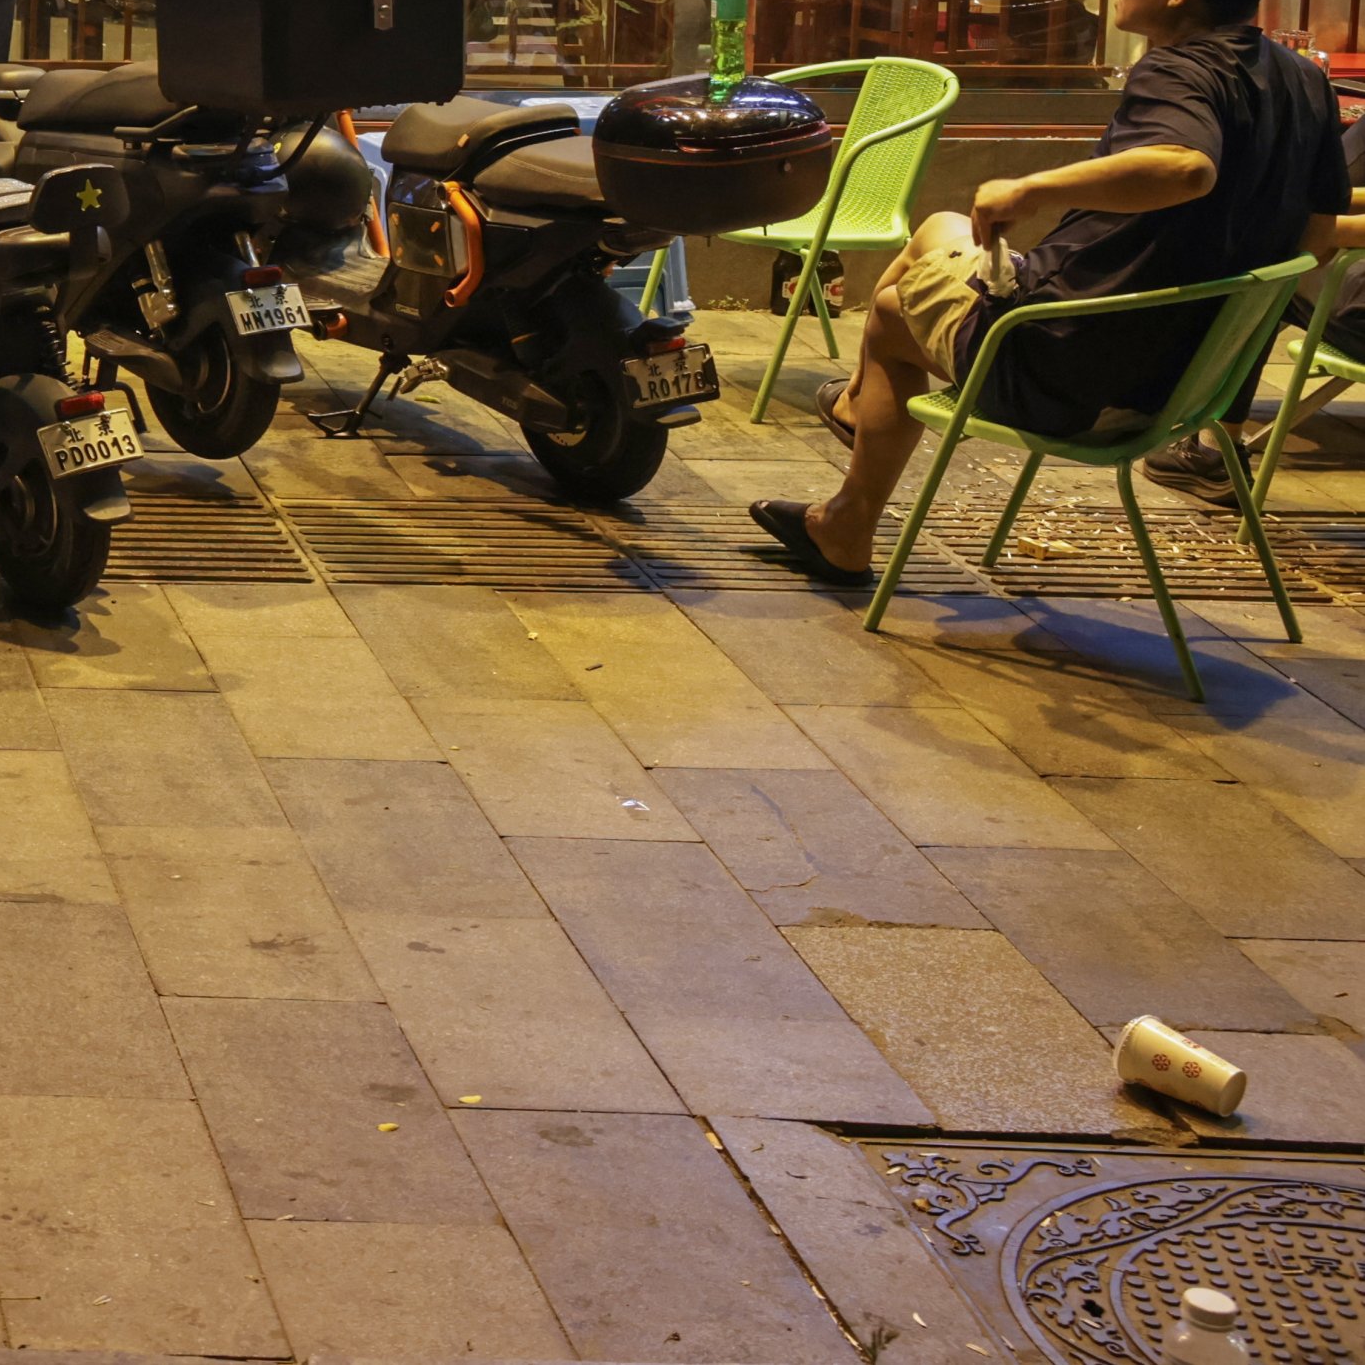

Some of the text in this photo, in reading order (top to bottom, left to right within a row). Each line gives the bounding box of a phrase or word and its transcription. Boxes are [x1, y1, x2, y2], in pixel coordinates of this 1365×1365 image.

[248, 288, 289, 309] 北京
[239, 305, 308, 332] MN1961
[648, 351, 689, 377] 北京
[67, 418, 114, 443] 北京
[54, 434, 136, 471] PD0013
[1253, 1246, 1365, 1281] 北京
